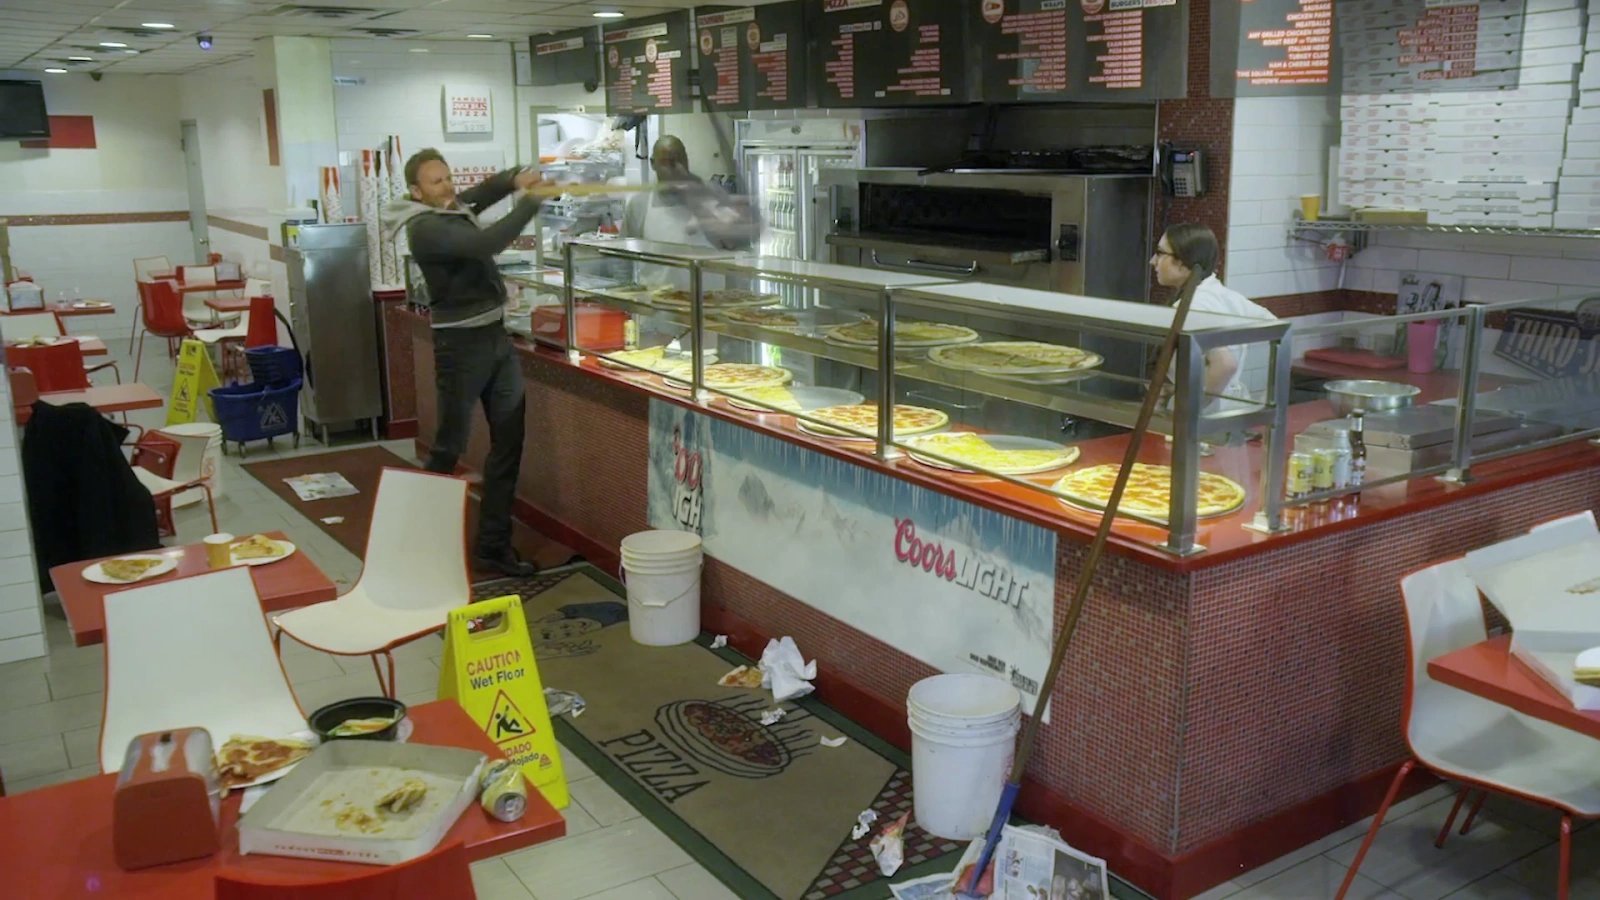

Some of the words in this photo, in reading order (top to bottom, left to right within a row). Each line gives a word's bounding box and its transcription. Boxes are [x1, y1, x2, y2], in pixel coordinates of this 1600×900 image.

[1286, 13, 1313, 21] CHICKEN
[1286, 29, 1312, 37] CHICKEN
[1508, 317, 1581, 370] THIRD
[894, 516, 957, 582] Coors
[955, 556, 1030, 610] LIGHT
[466, 649, 521, 676] CAUTION
[470, 676, 494, 690] Wet
[496, 668, 525, 684] Floor
[597, 729, 711, 804] PIZZA
